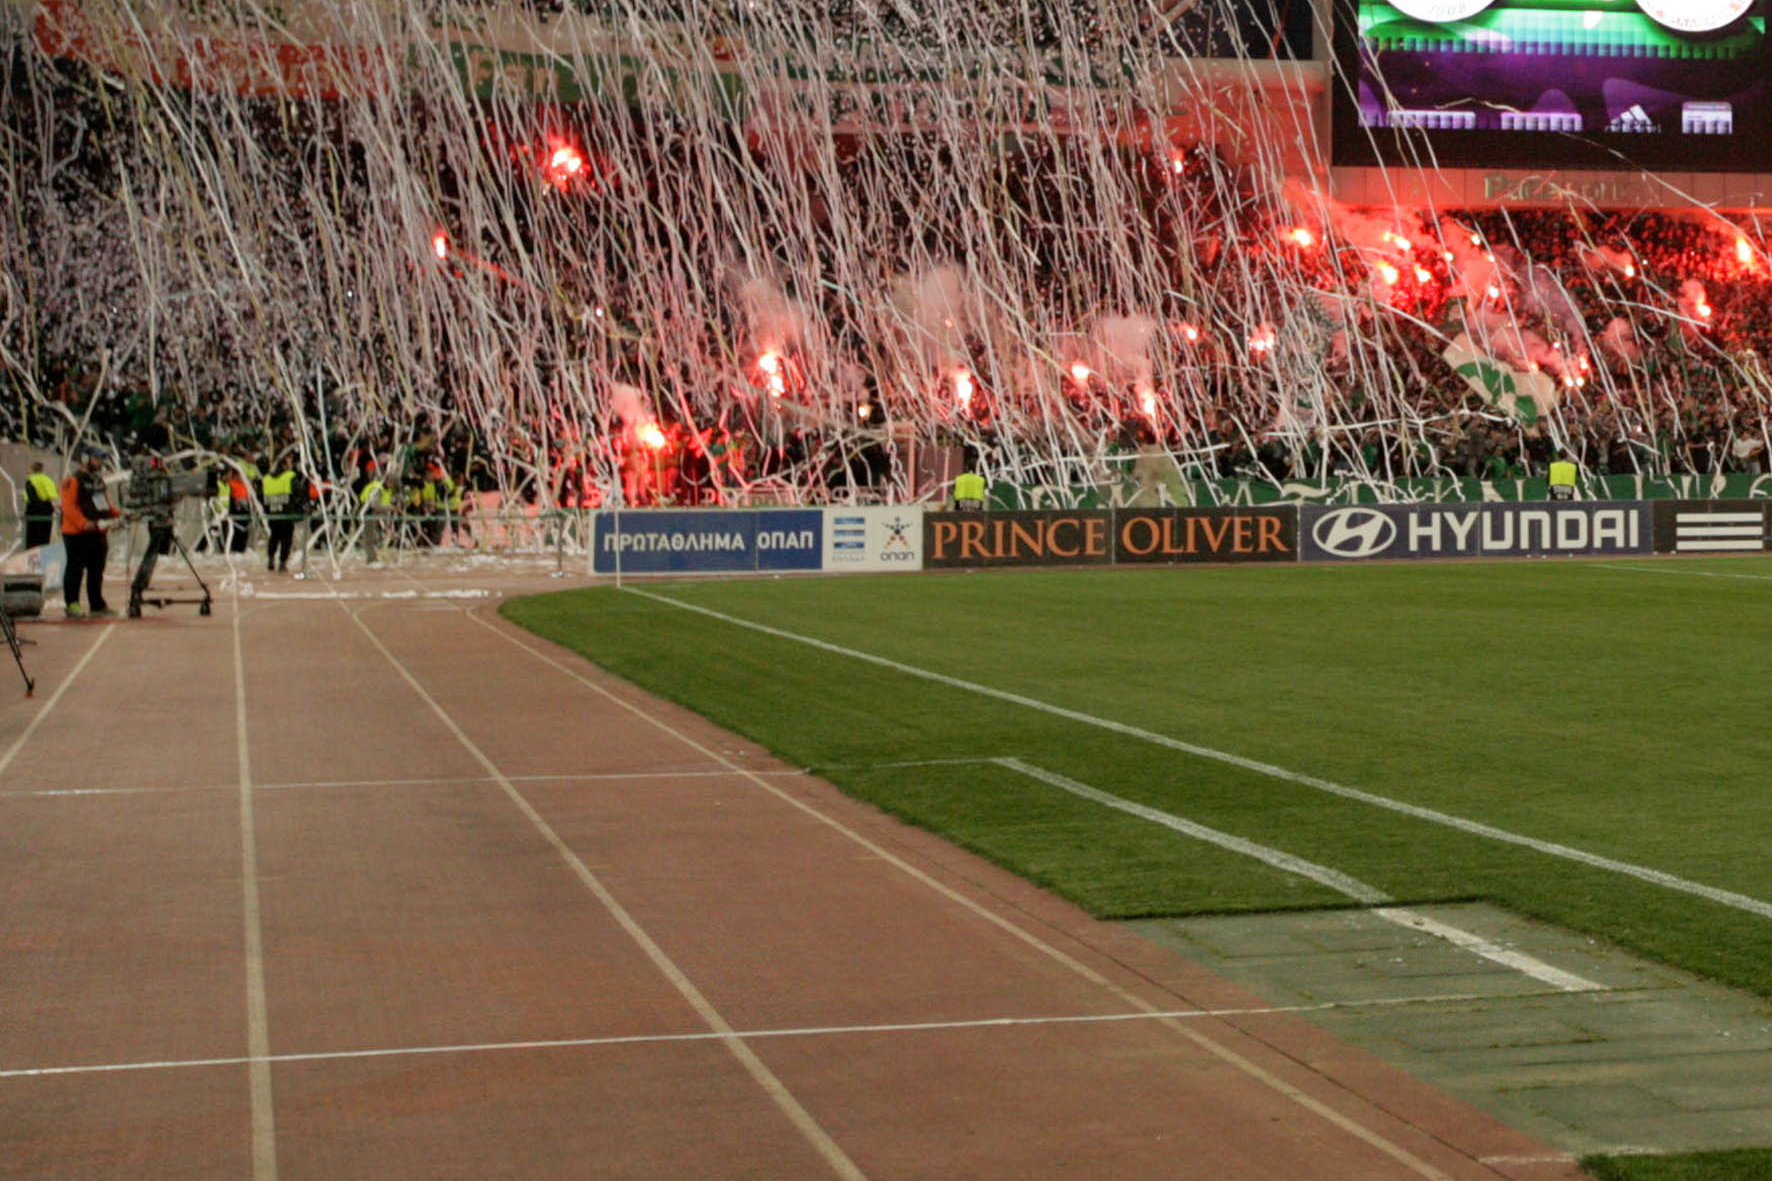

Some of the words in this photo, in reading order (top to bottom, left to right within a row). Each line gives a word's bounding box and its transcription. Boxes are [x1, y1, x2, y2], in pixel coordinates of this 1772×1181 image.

[604, 532, 745, 551] ΠΡΩΤΑΘΛΗΜΑ
[757, 531, 814, 550] ΟΠΑΠ
[931, 518, 1106, 559] PRINCE
[1121, 516, 1292, 555] OLIVER
[1408, 509, 1639, 551] HYUNDAI
